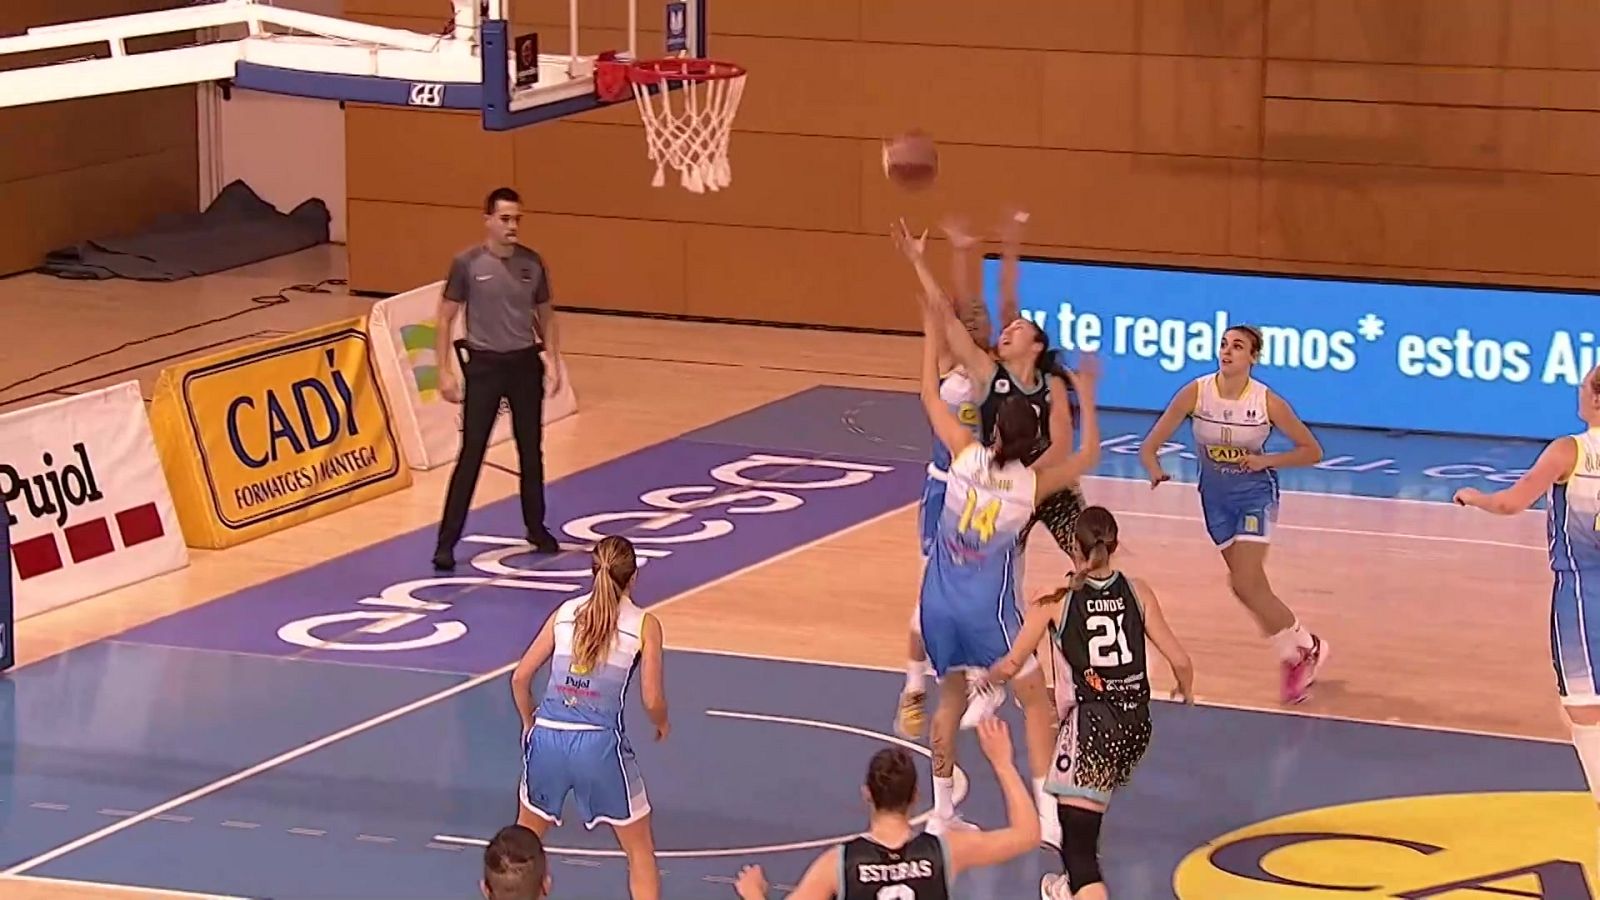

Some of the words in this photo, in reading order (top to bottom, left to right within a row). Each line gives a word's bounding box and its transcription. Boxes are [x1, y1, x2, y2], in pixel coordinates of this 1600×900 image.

[1058, 302, 1101, 351] te
[1114, 310, 1384, 371] regalmos
[1398, 328, 1531, 383] estos
[1541, 330, 1600, 385] Ai
[227, 349, 359, 468] CADÍ
[0, 442, 104, 527] Pujol
[234, 467, 313, 509] FORMATGES
[320, 445, 378, 480] MANTEGA
[958, 486, 1002, 544] 14
[276, 454, 895, 652] endesa
[1086, 597, 1126, 612] CONDE
[1086, 613, 1133, 667] 21
[564, 675, 590, 689] Pujol
